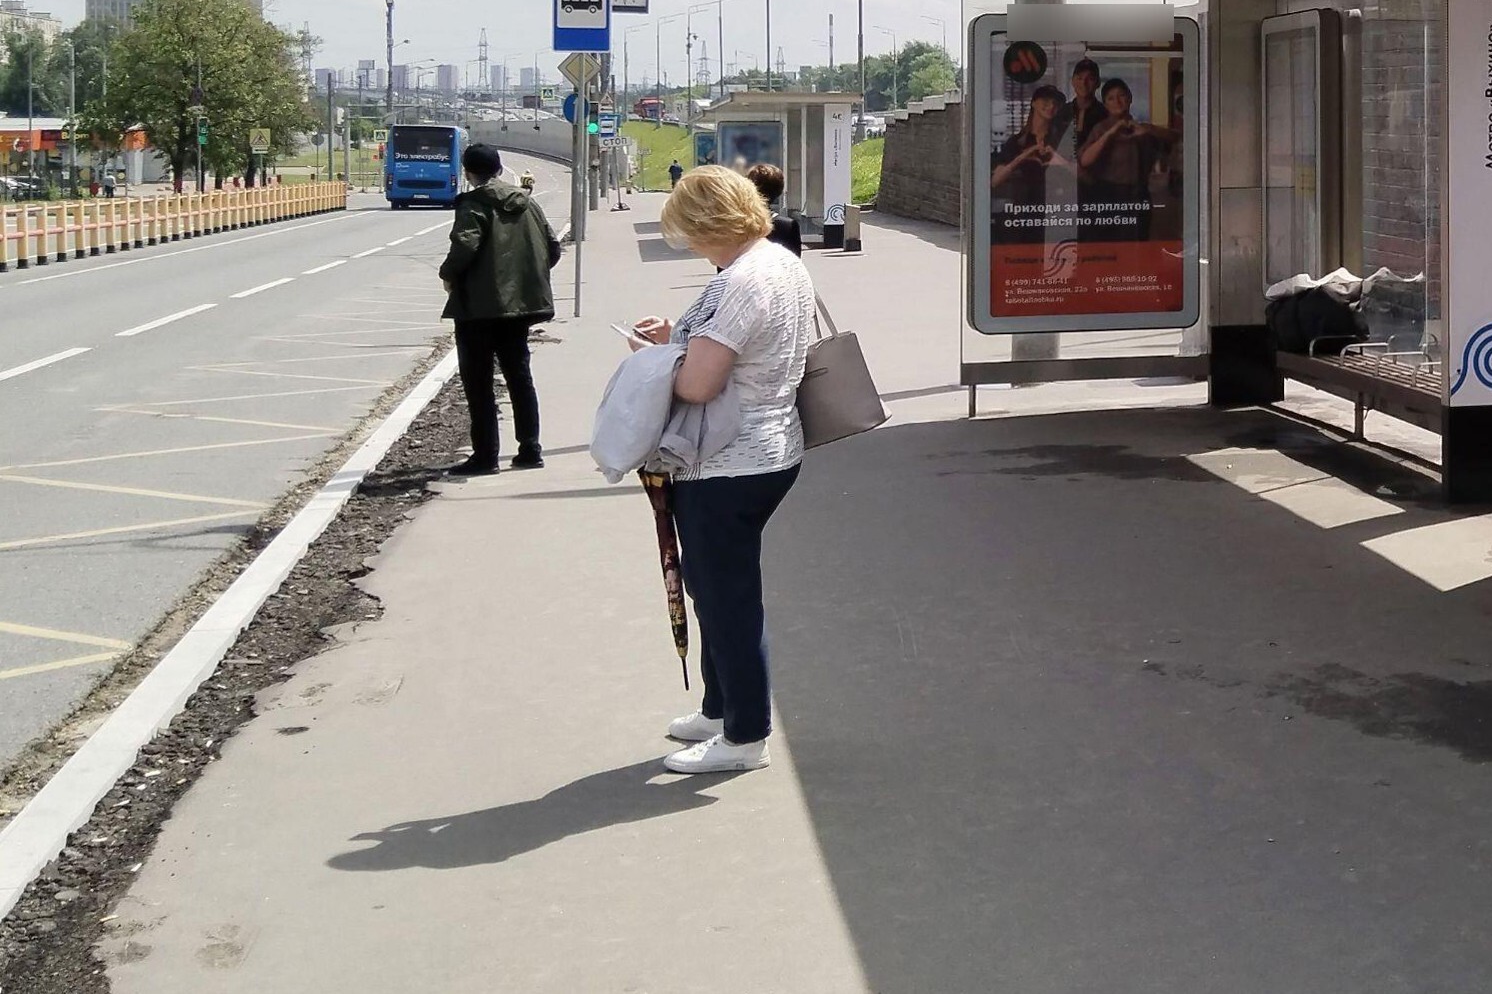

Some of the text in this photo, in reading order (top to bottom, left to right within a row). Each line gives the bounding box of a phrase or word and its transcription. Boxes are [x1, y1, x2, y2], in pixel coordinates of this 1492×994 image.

[409, 153, 450, 161] электробус
[1004, 203, 1061, 215] Приходи
[1063, 203, 1079, 212] за
[1082, 200, 1150, 213] зарплатой
[1004, 215, 1137, 227] оставайся по любви
